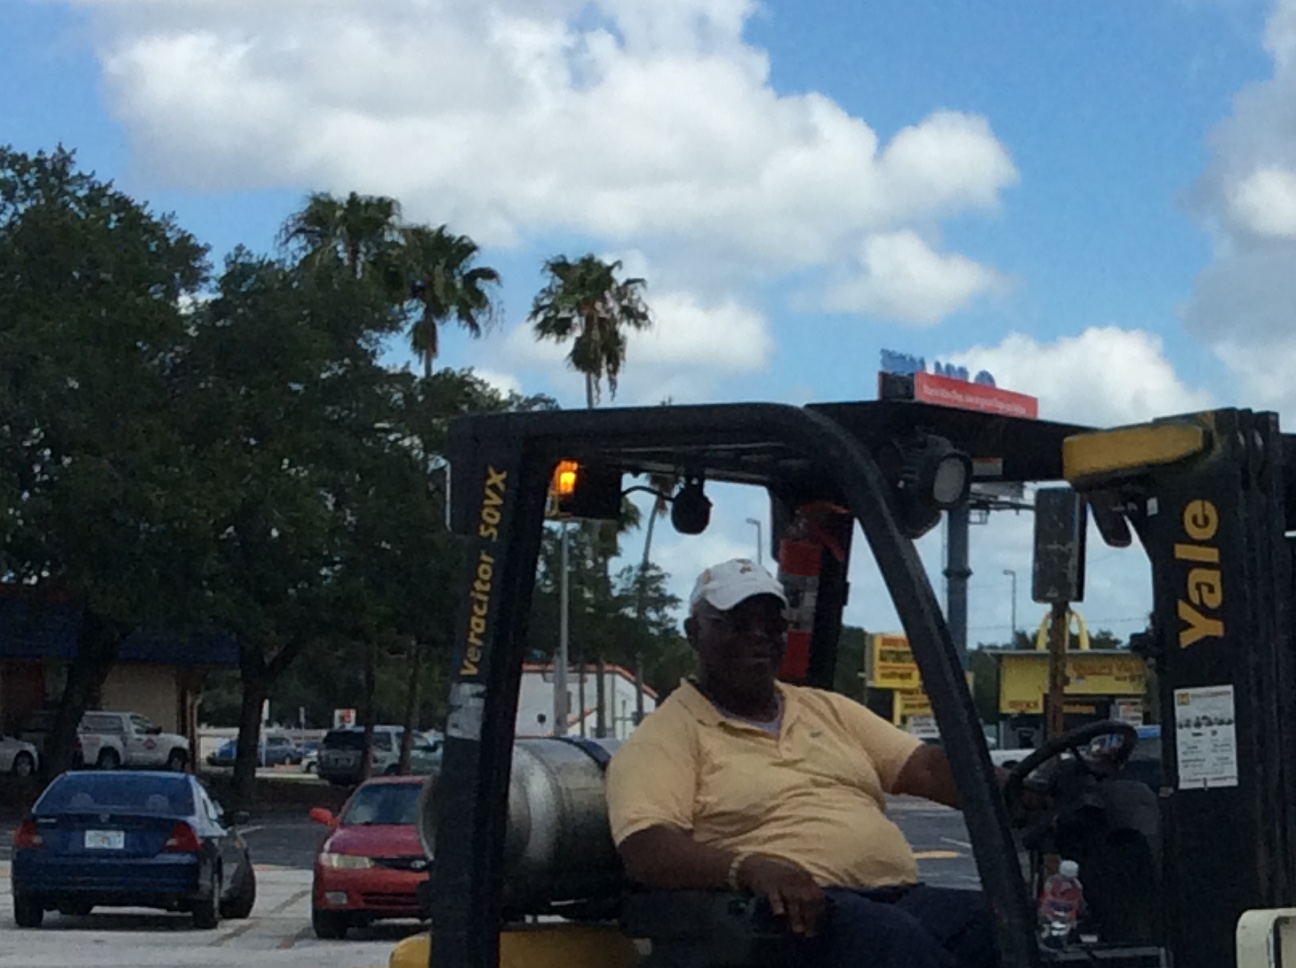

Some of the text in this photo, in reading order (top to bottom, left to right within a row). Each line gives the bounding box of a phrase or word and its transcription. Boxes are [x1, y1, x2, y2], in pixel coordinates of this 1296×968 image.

[460, 465, 508, 676] Veracitor 50VX
[1174, 499, 1224, 649] Yale
